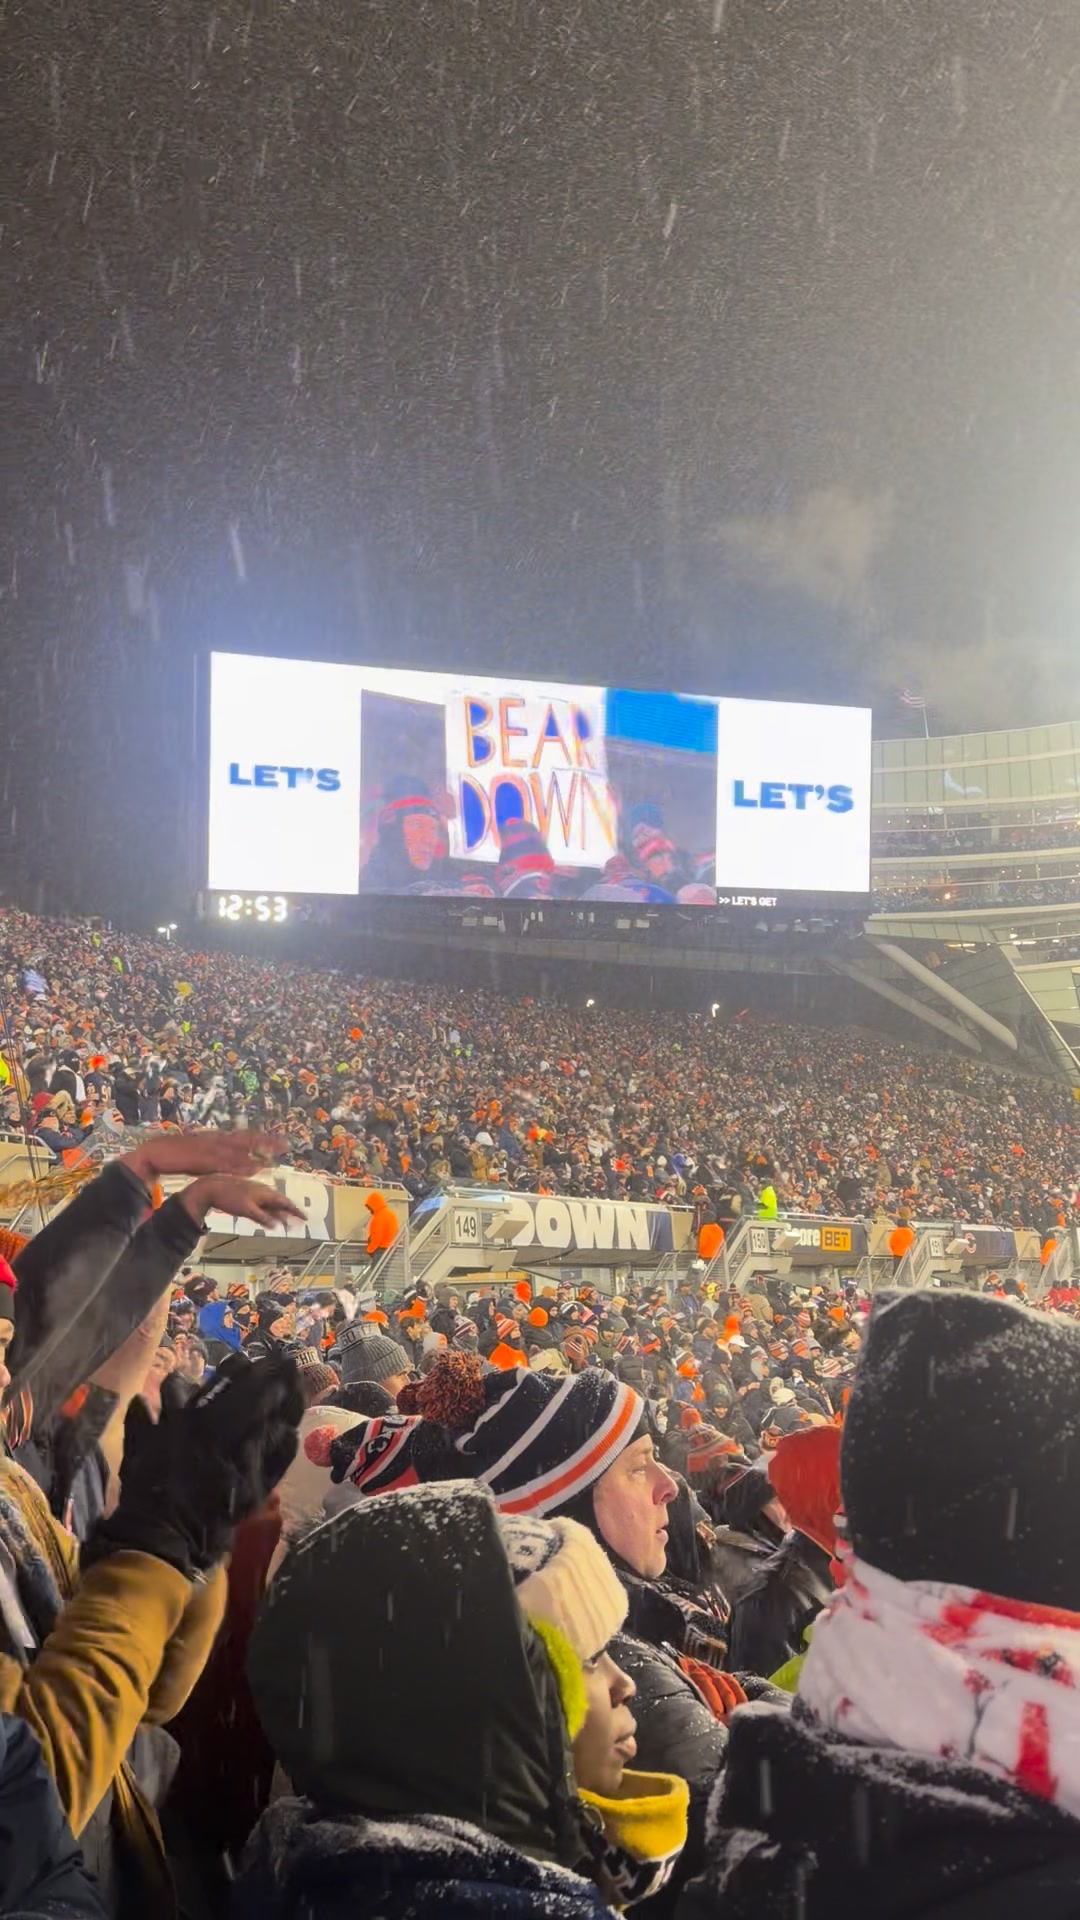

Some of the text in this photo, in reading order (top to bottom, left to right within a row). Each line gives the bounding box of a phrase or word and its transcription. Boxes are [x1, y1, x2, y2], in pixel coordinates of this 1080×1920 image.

[464, 696, 597, 769] BEAR
[229, 762, 341, 791] LET'S
[733, 779, 854, 813] LET'S
[458, 770, 619, 853] DOWN
[218, 894, 288, 922] 12:53
[732, 896, 777, 907] LET'S GET
[456, 1215, 477, 1238] 149
[494, 1198, 651, 1250] DOWN
[824, 1230, 849, 1247] BET
